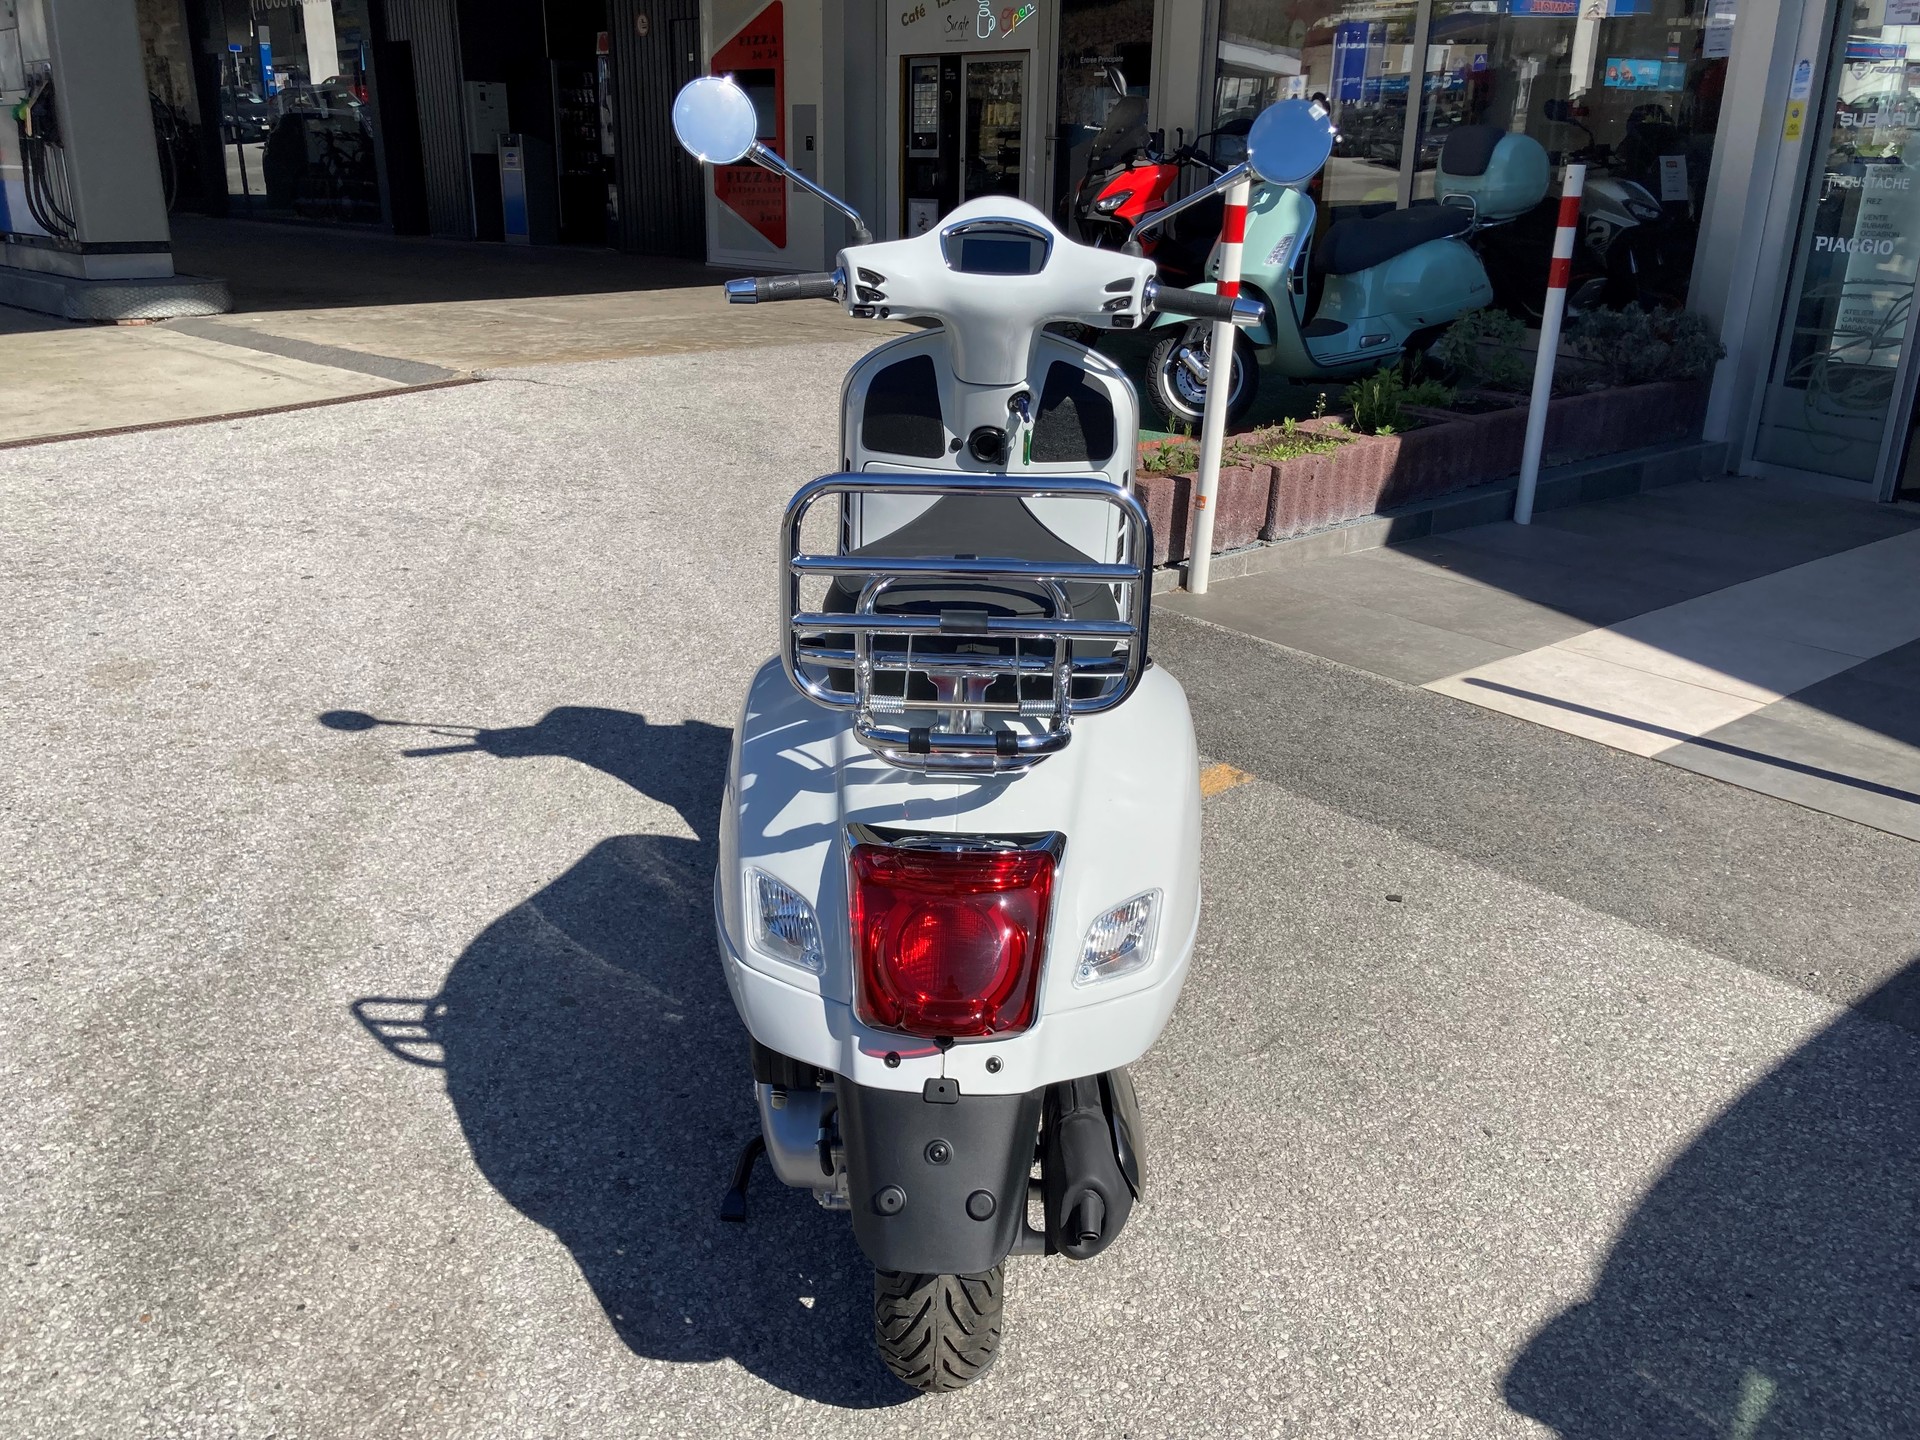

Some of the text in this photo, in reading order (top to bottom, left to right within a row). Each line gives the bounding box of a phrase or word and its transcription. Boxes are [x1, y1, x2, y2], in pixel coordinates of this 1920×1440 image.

[901, 4, 926, 26] Café
[1000, 3, 1034, 33] Open
[739, 35, 777, 46] PIZZA
[1098, 56, 1124, 64] Principale
[1839, 112, 1920, 128] SUBARU
[1866, 197, 1882, 205] REZ
[1860, 230, 1900, 238] OCCASION
[1815, 236, 1894, 255] PIAGGIO
